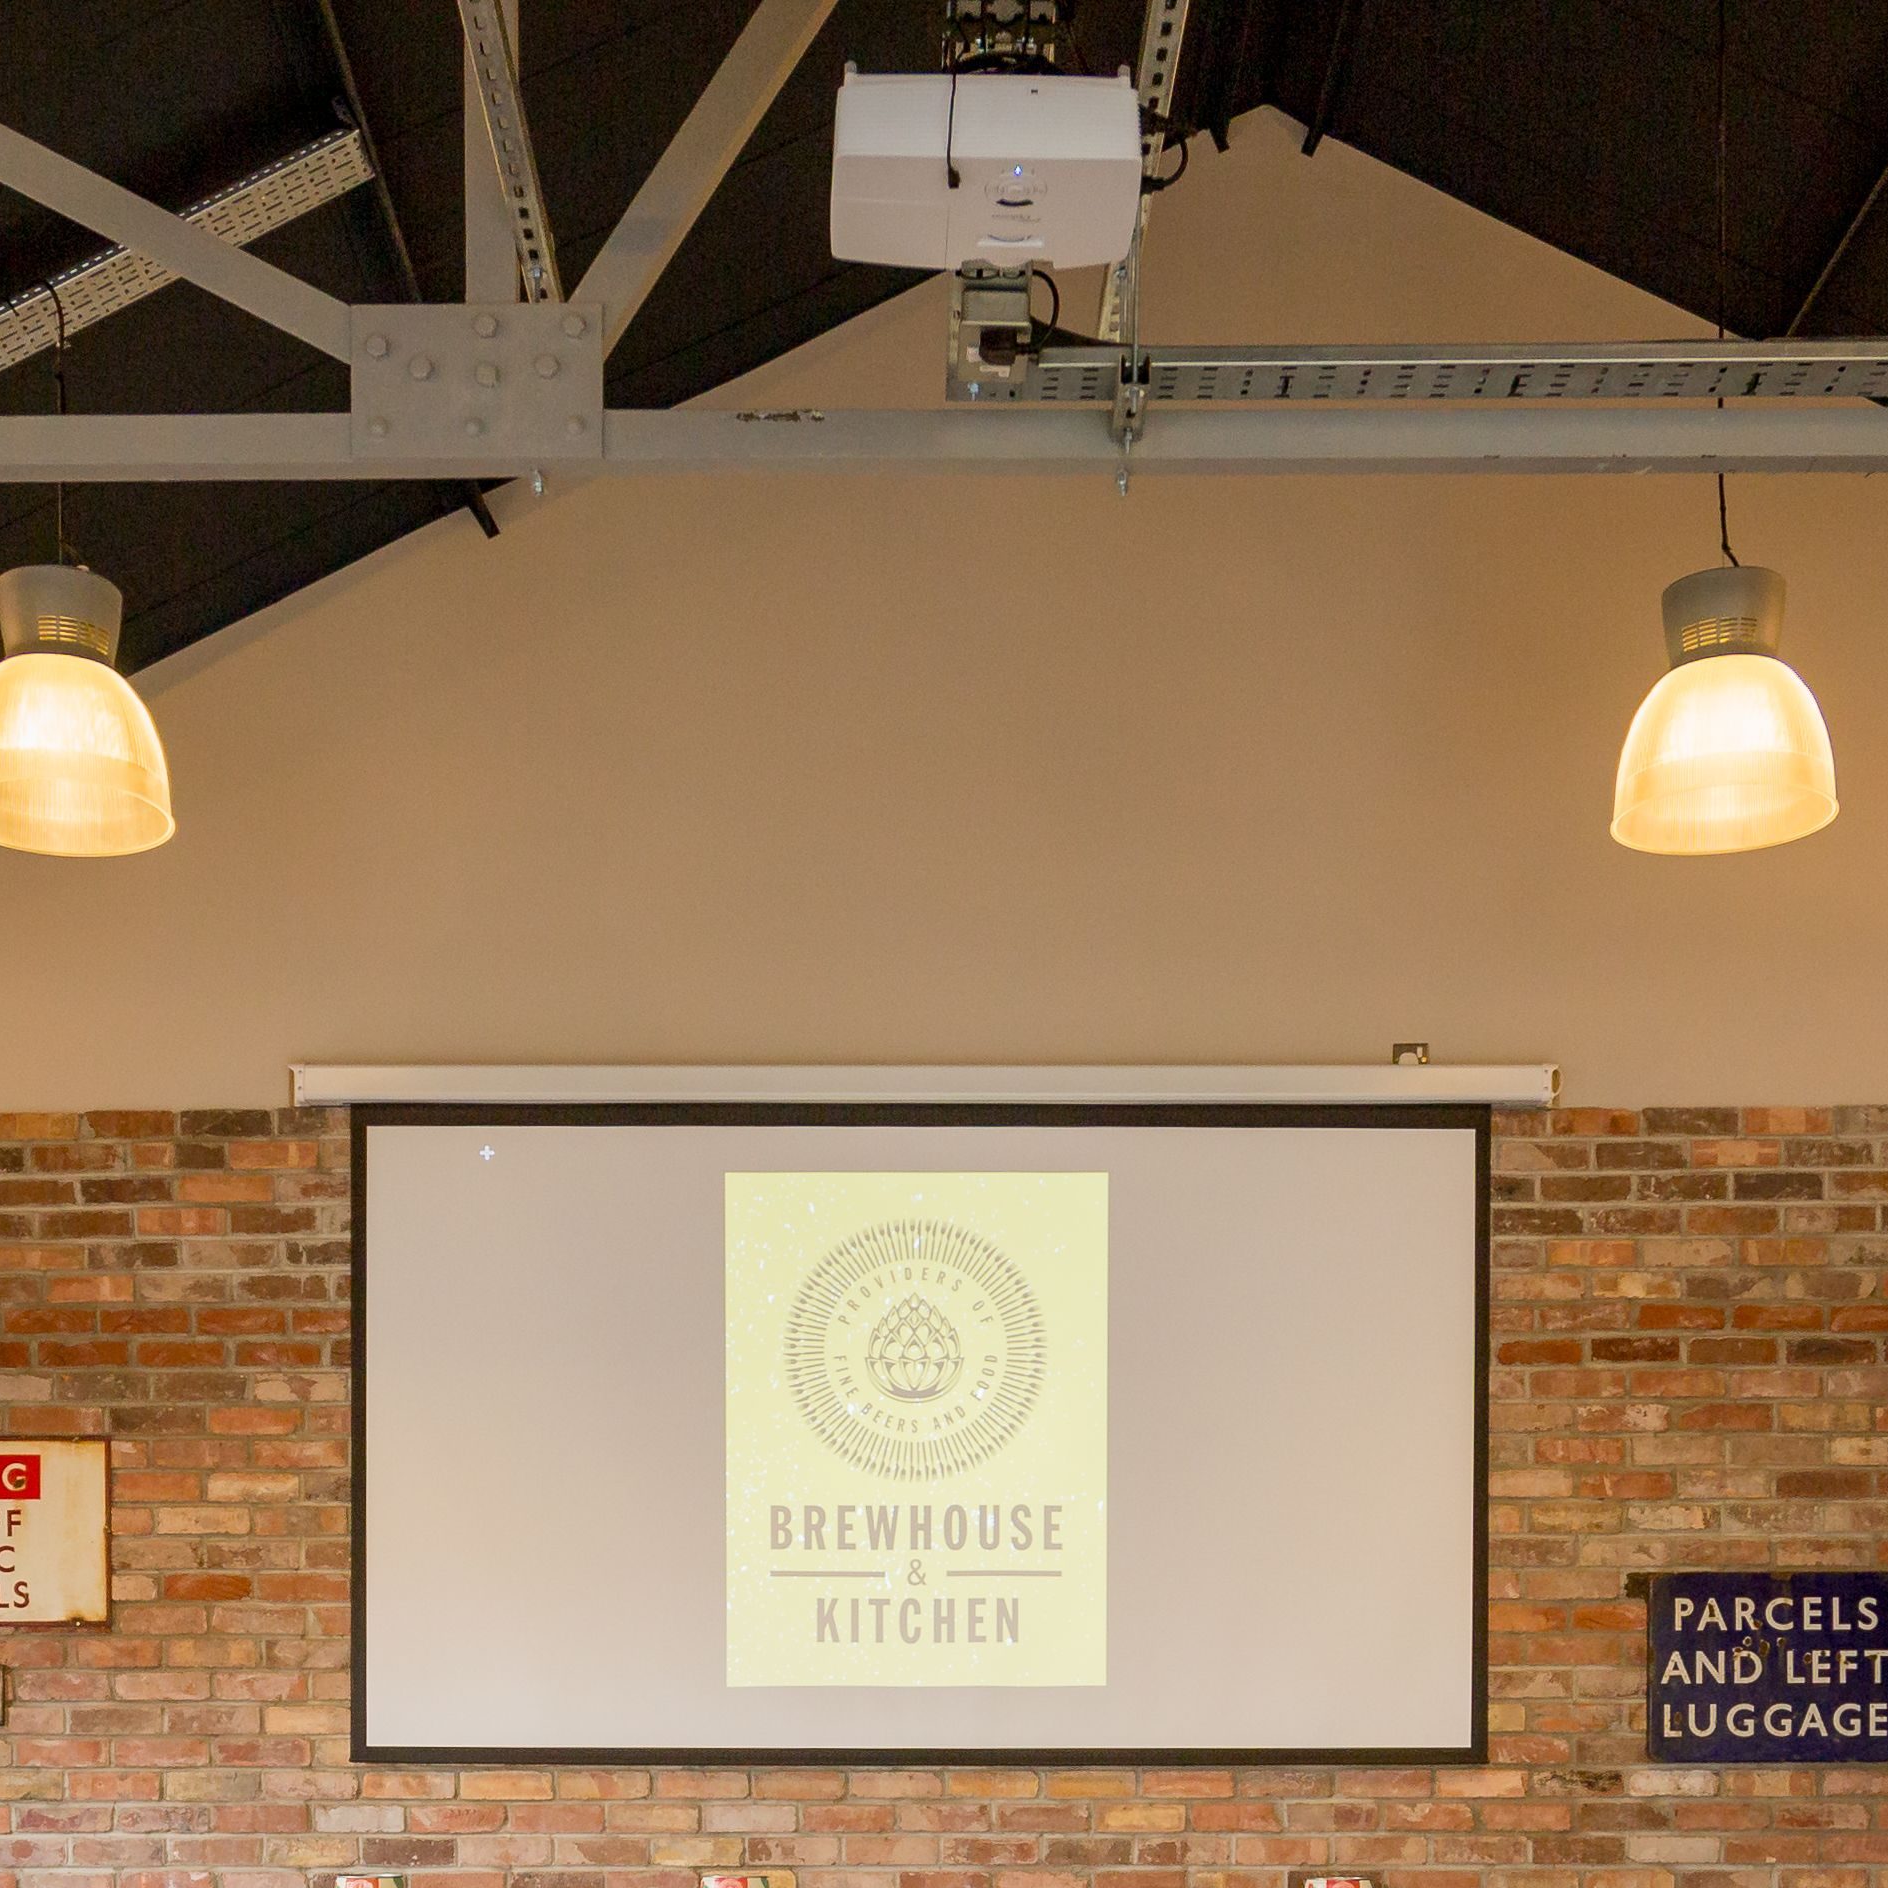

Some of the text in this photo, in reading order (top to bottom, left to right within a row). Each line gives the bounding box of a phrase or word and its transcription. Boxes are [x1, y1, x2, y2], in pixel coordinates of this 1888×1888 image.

[837, 1266, 994, 1326] PROVIDERS OF
[833, 1354, 998, 1433] FINE BEERS AND FOOD
[770, 1504, 1063, 1550] BREWHOUSE
[907, 1559, 927, 1586] &
[816, 1598, 1019, 1643] KITCHEN
[1674, 1597, 1879, 1631] PARCELS
[1661, 1649, 1763, 1684] AND
[1663, 1703, 1888, 1738] LUGGAGE
